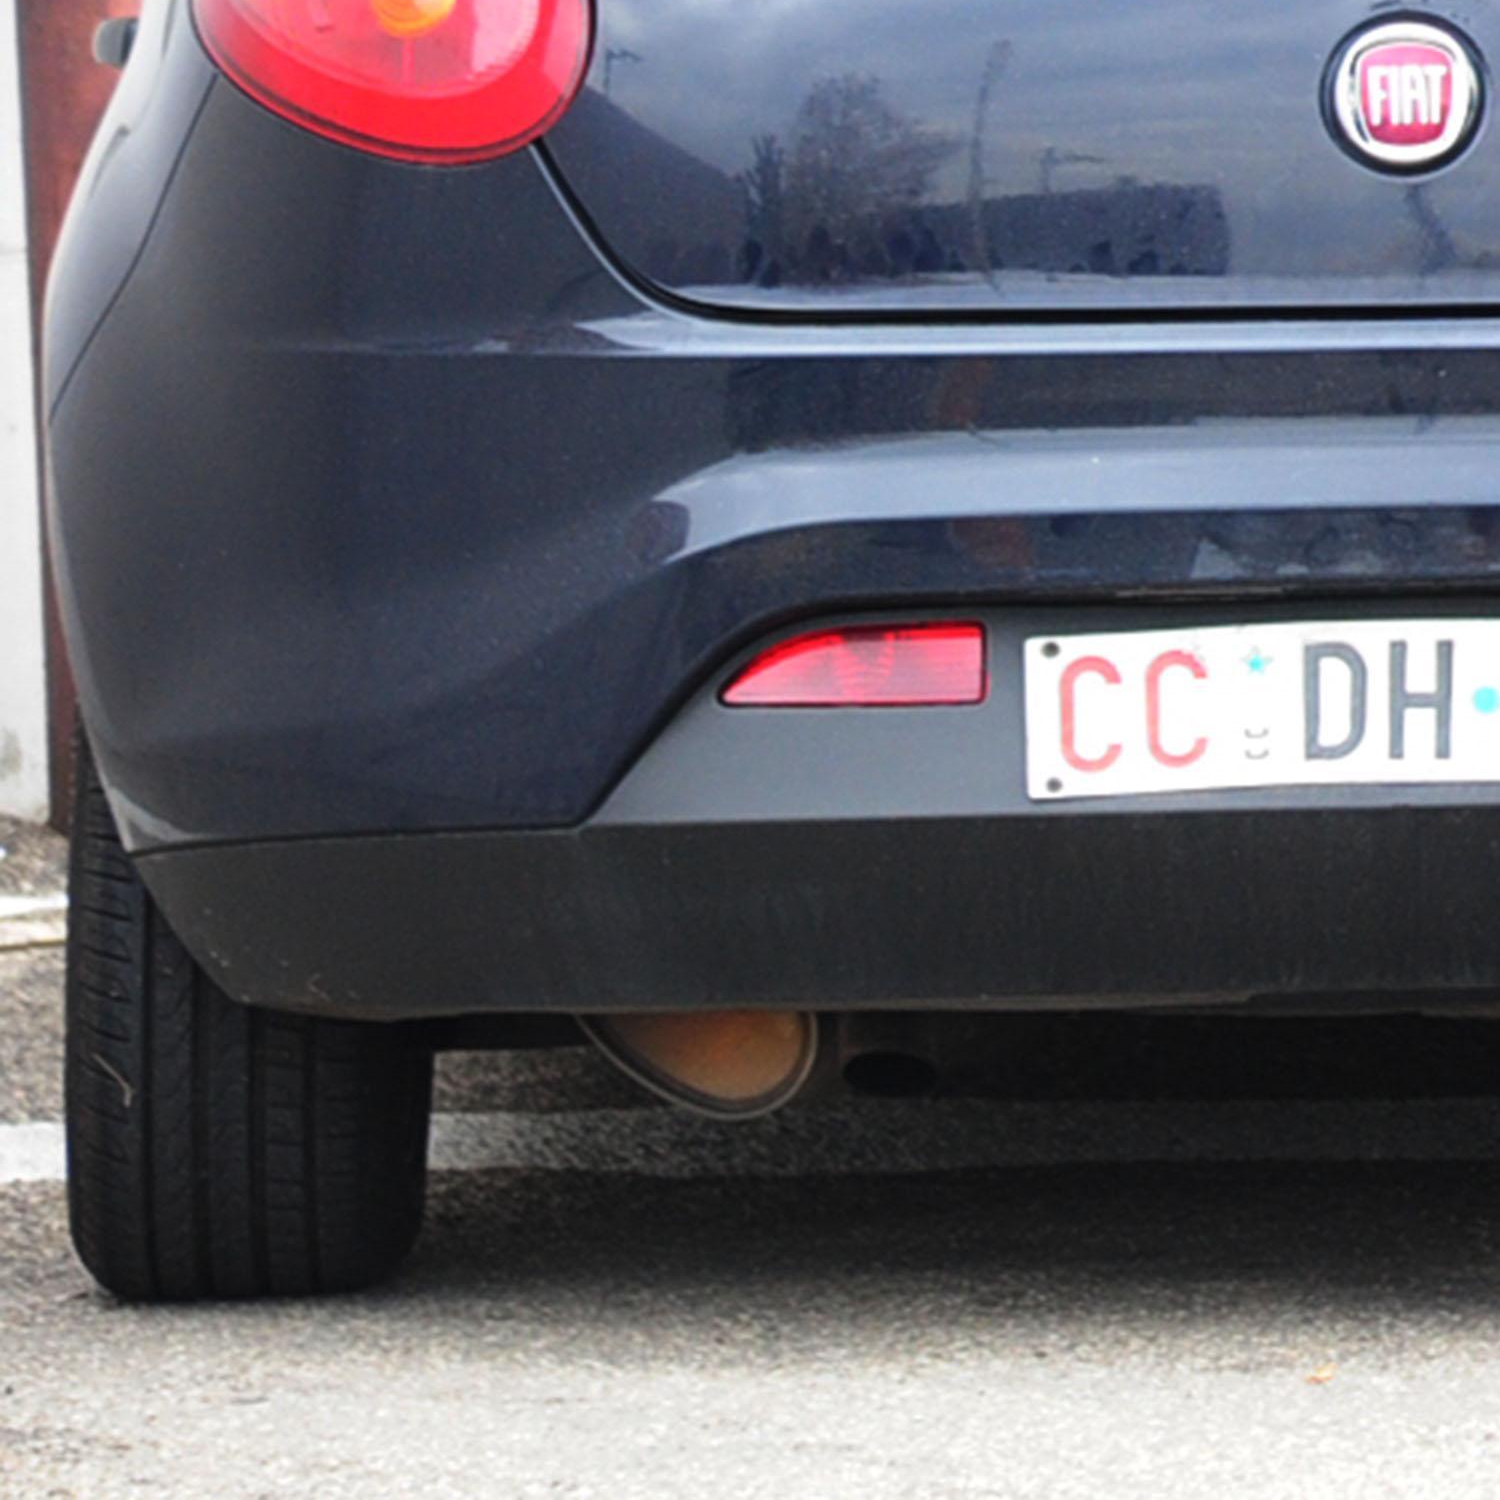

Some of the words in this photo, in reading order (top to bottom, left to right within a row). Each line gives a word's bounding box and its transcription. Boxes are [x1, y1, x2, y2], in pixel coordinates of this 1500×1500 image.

[1366, 64, 1448, 127] FIAT
[1059, 649, 1208, 772] CC
[1302, 639, 1455, 761] DH
